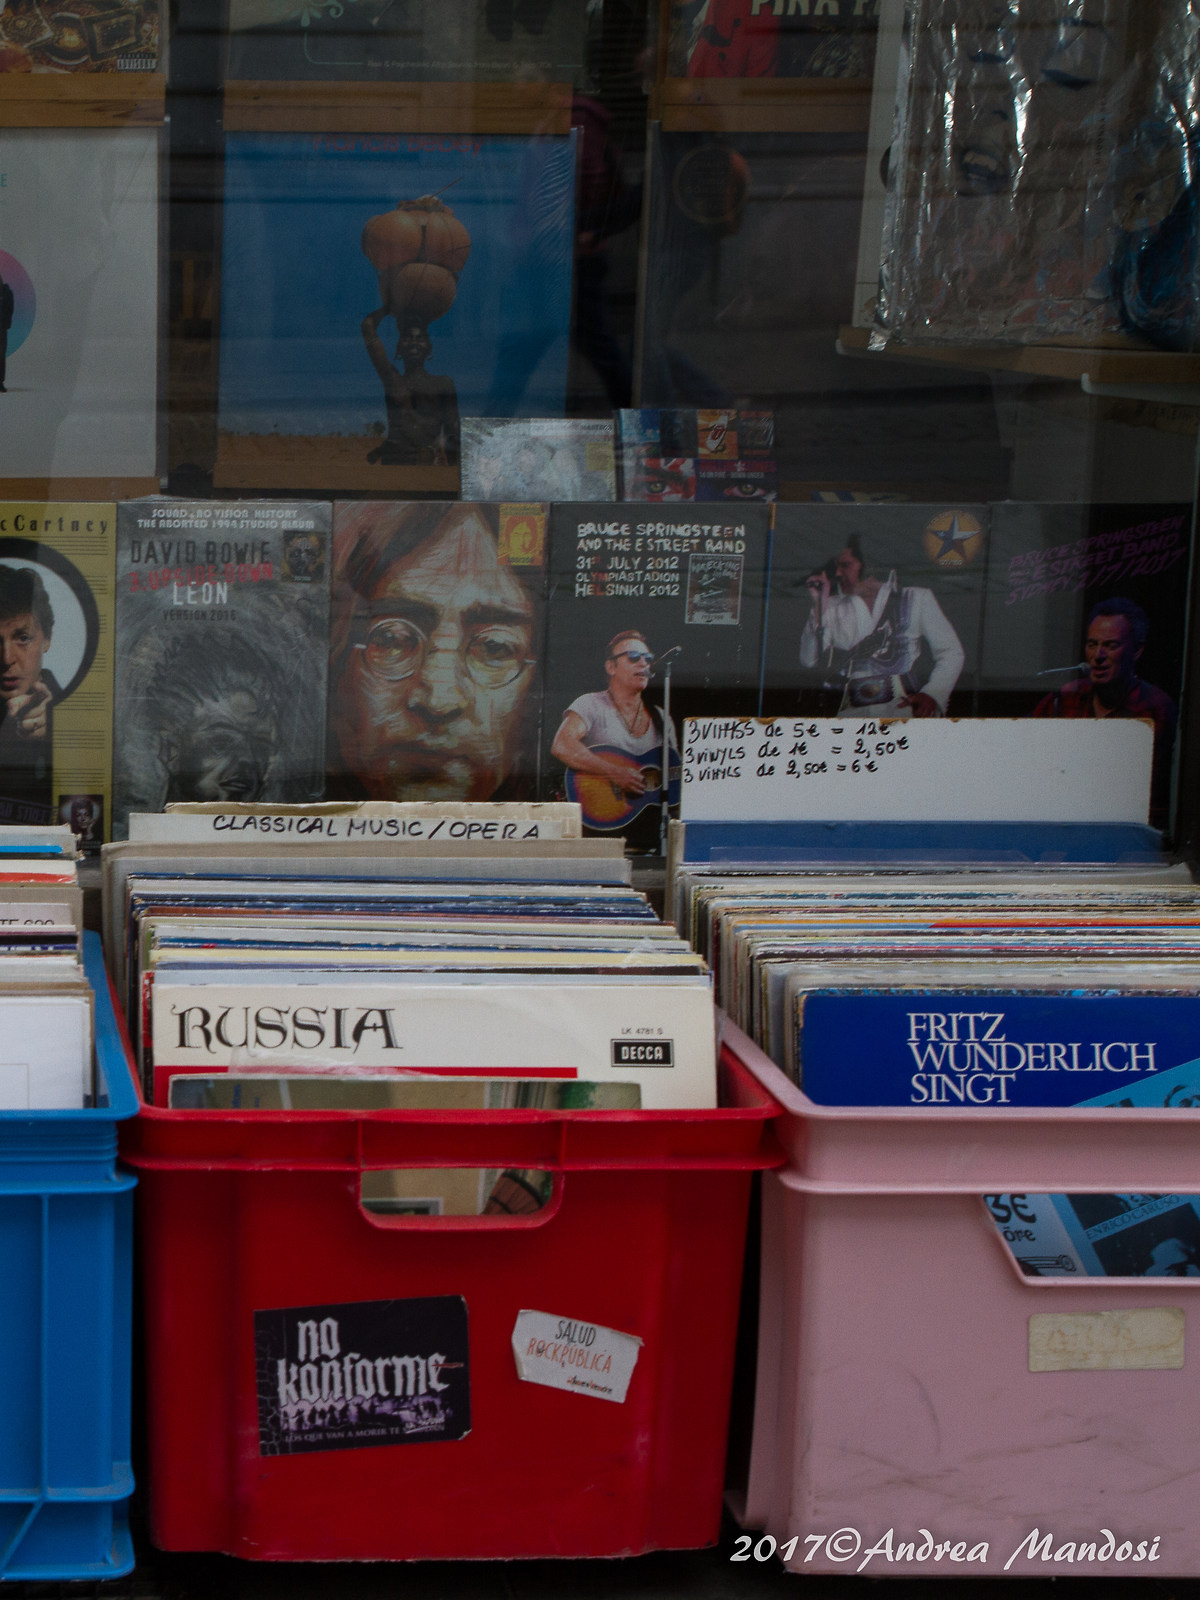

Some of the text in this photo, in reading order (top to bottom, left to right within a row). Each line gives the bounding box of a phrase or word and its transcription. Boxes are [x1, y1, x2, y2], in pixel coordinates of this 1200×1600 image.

[151, 508, 188, 519] SOUND
[254, 509, 298, 519] HISTORY
[136, 519, 315, 529] THE ABORTED 1994 STUDIO ALBUM
[577, 522, 747, 538] BRUCE SPRINGSTEEN
[1070, 514, 1187, 556] SPRINGSTEEN
[130, 540, 272, 565] DAVID BOWIE
[577, 539, 747, 553] AND THE E STREET BAND
[1121, 532, 1182, 560] BAND
[606, 556, 642, 570] JULY
[645, 556, 681, 571] 2012
[575, 571, 680, 583] OLYMPIASTADION
[171, 581, 229, 606] LEON
[575, 583, 681, 598] HELSINKI 2012
[162, 609, 208, 621] VERSION
[765, 723, 784, 737] de
[758, 741, 781, 758] de
[756, 764, 776, 777] de
[212, 815, 339, 836] CLASSICAL
[169, 1005, 404, 1055] RUSSIA
[906, 1012, 1006, 1043] FRITZ
[621, 1046, 663, 1060] DECCA
[907, 1042, 1159, 1074] WUNDERLICH
[910, 1074, 1017, 1104] SINGT
[296, 1316, 342, 1363] no
[555, 1320, 597, 1347] SALUD
